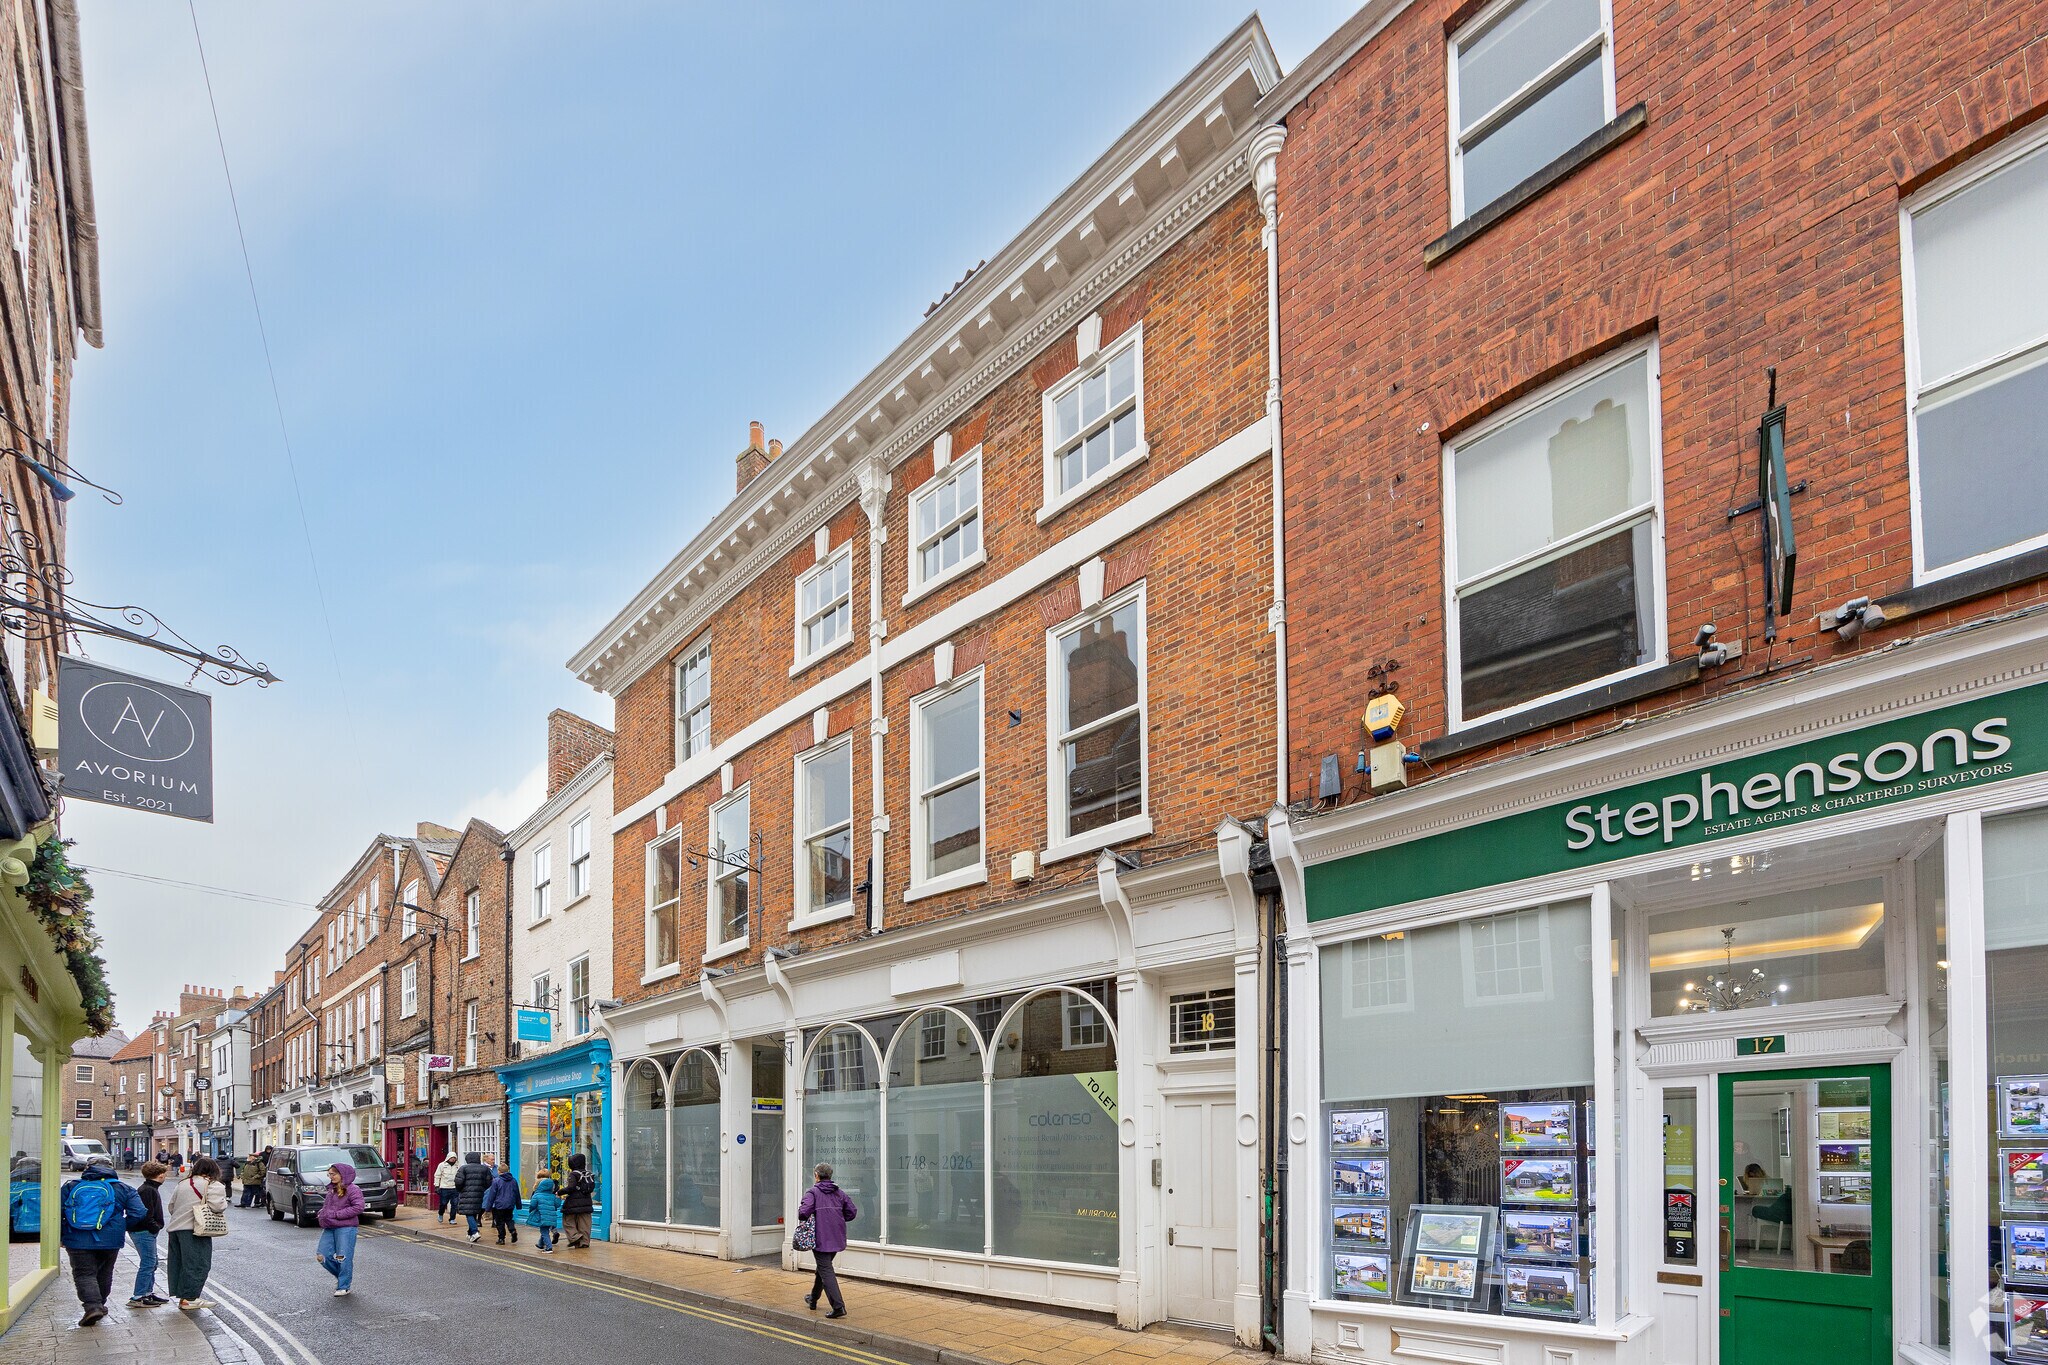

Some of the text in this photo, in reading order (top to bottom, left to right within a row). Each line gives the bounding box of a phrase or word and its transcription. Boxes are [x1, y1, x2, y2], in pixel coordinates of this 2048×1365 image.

[75, 760, 198, 795] AVORIUM
[1565, 717, 2012, 850] Stephensons
[103, 789, 173, 812] Est. 2021
[1704, 762, 2013, 836] ESTATE AGENTS & CHARTERED SURVEYORS
[1201, 1012, 1215, 1032] 18
[1753, 1037, 1775, 1053] 17
[556, 1073, 571, 1084] Hospice
[571, 1071, 582, 1081] Shop
[1086, 1077, 1116, 1111] TO LET
[1029, 1111, 1092, 1126] colenso
[898, 1155, 926, 1170] 1748
[942, 1155, 973, 1170] 2026
[2009, 1153, 2030, 1168] SOLD
[1676, 1241, 1684, 1252] S
[2014, 1300, 2037, 1314] SOLD
